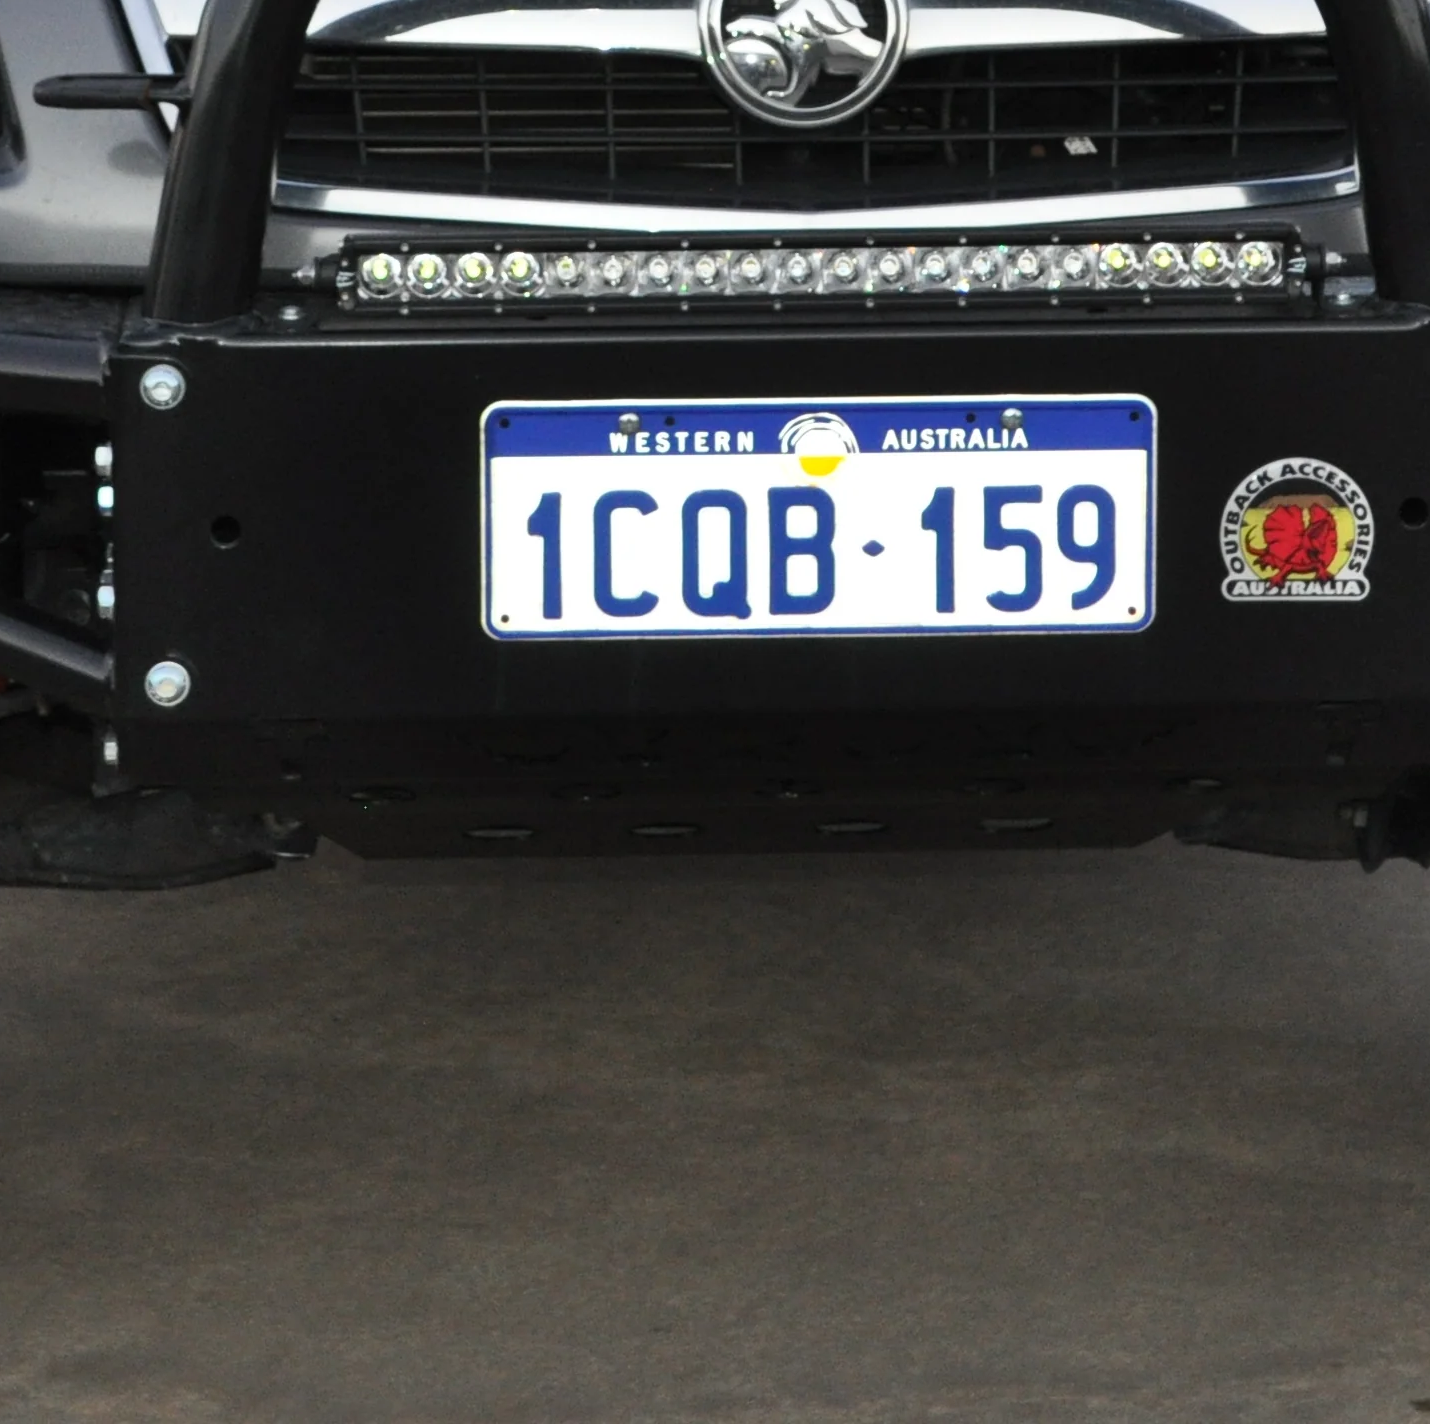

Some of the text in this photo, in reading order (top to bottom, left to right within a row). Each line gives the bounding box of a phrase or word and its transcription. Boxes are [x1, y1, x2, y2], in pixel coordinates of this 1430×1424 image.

[609, 428, 1030, 454] WESTERN AUSTRALIA
[1224, 462, 1371, 574] OUTBACK ACCESSORIES
